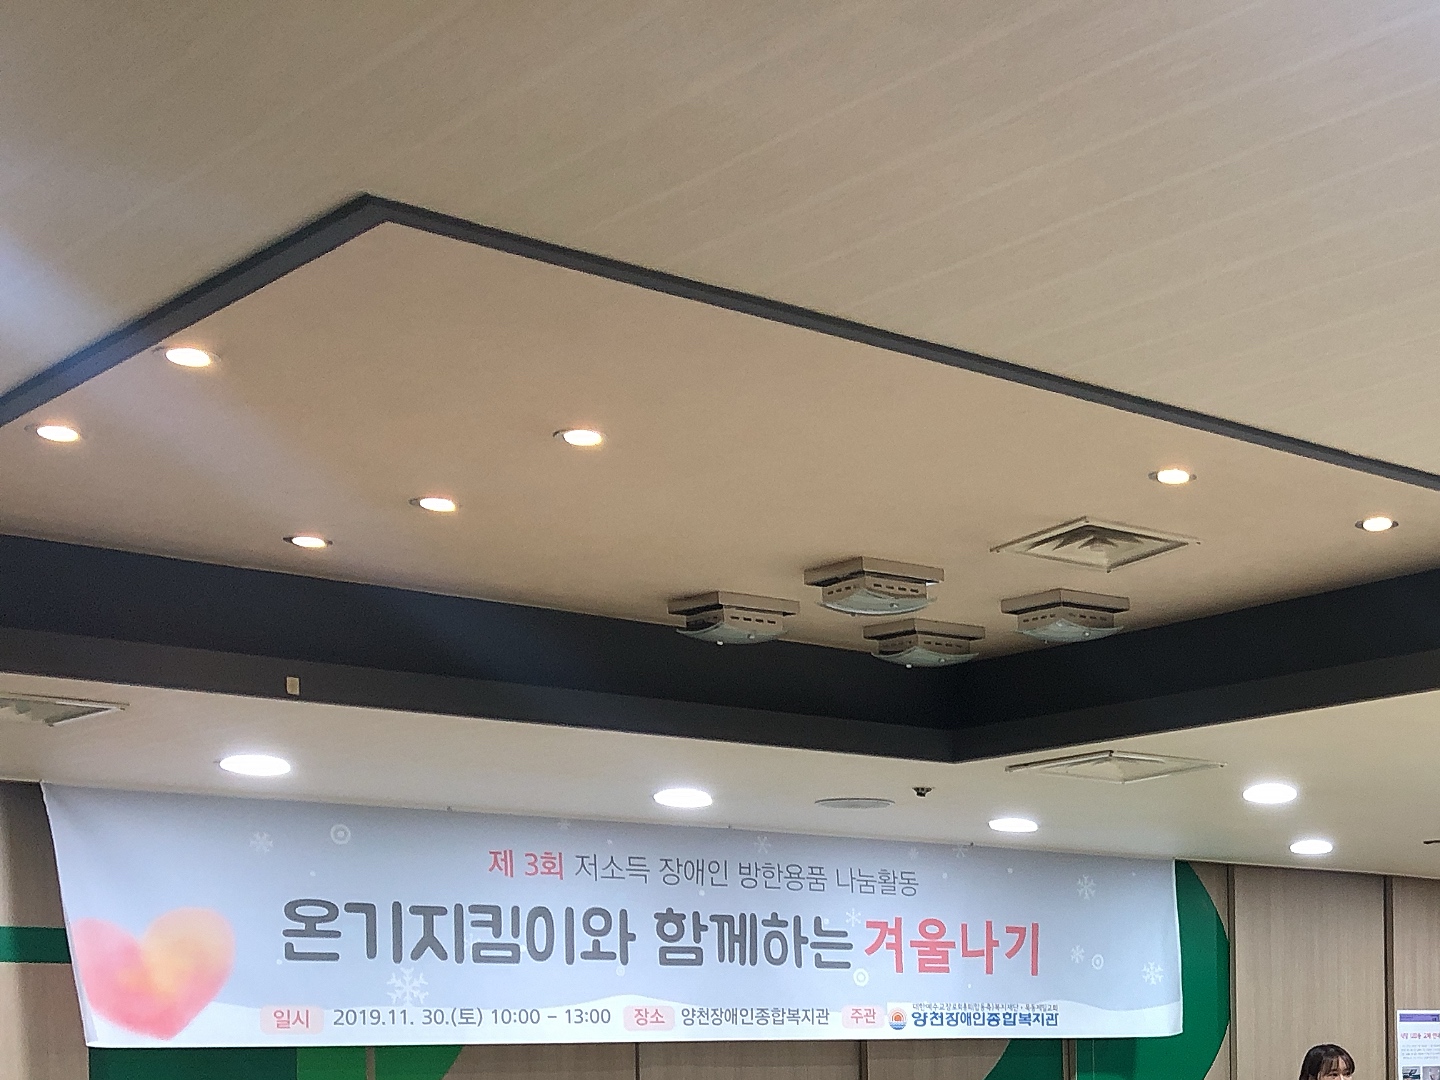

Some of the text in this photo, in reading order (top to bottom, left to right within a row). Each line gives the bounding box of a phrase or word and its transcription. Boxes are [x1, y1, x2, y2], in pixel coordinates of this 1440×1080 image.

[488, 849, 919, 897] 제 3회 저소득 장애인 방한용품 나눔활동
[282, 898, 1039, 976] 온기지킴이와 함께하는 겨울나기
[273, 1008, 310, 1029] 일시
[333, 1008, 414, 1026] 2019.11.
[421, 1007, 483, 1028] 30.(토)
[491, 1008, 540, 1025] 10:00
[565, 1008, 611, 1024] 13:00
[634, 1007, 666, 1027] 장소
[681, 1007, 830, 1027] 양천장애인종합복지관
[850, 1007, 876, 1025] 주관
[911, 1011, 1059, 1027] 양천장애인종합복지관
